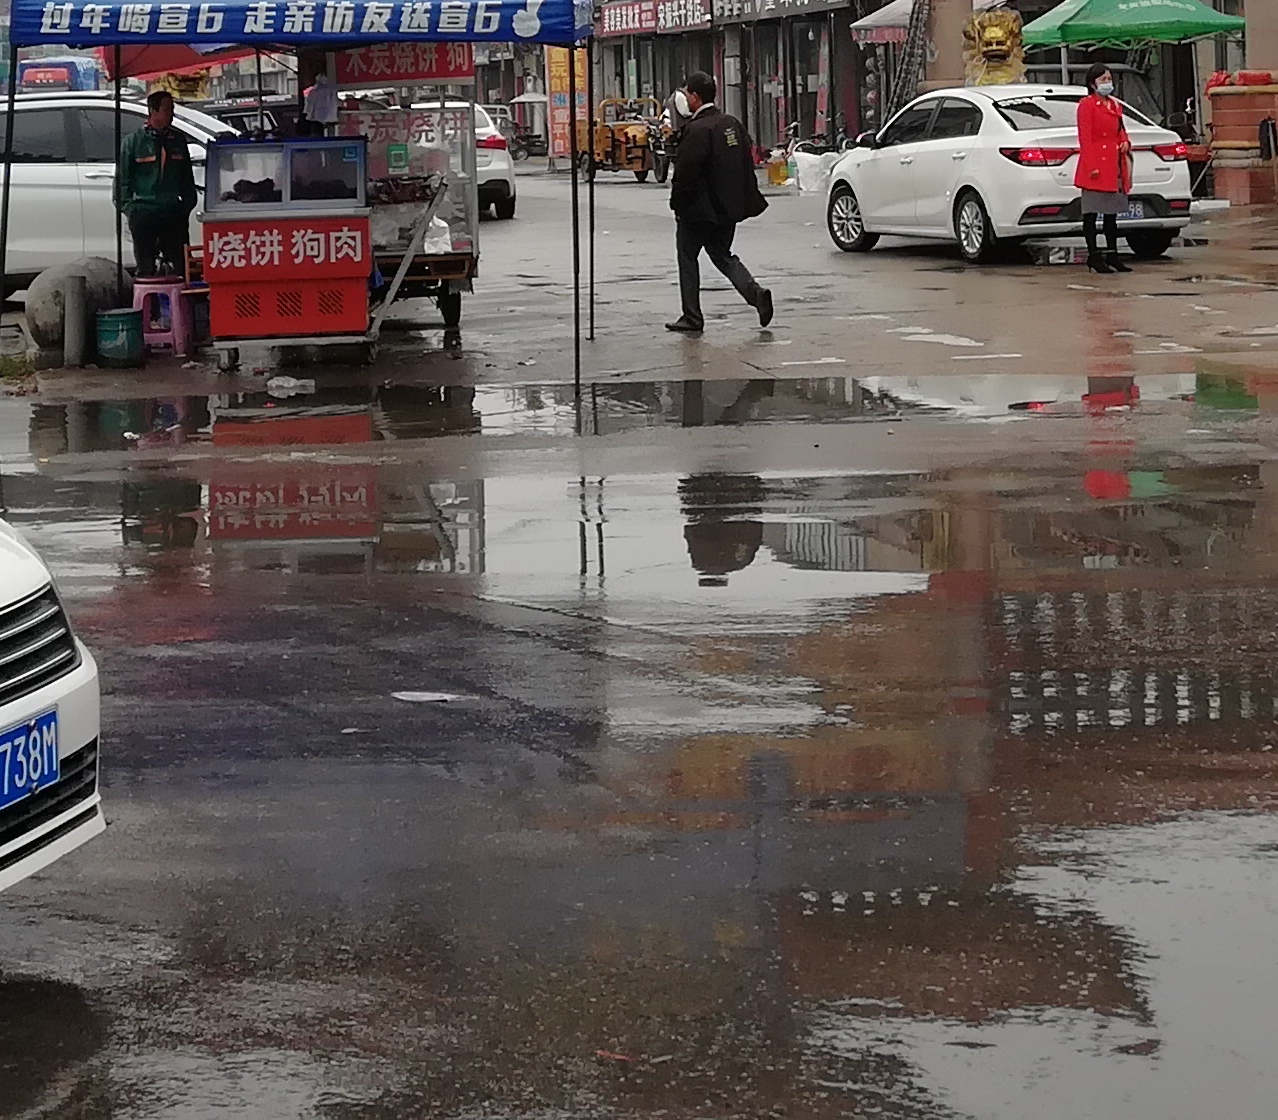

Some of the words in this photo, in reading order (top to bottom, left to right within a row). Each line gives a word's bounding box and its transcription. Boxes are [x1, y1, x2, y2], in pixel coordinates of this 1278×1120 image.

[40, 1, 226, 34] 过年喝宣6
[243, 0, 503, 34] 走亲访友送宣6
[344, 42, 439, 77] 木炭烧饼
[446, 42, 470, 71] 狗
[208, 228, 283, 269] 烧饼
[290, 226, 363, 265] 狗肉
